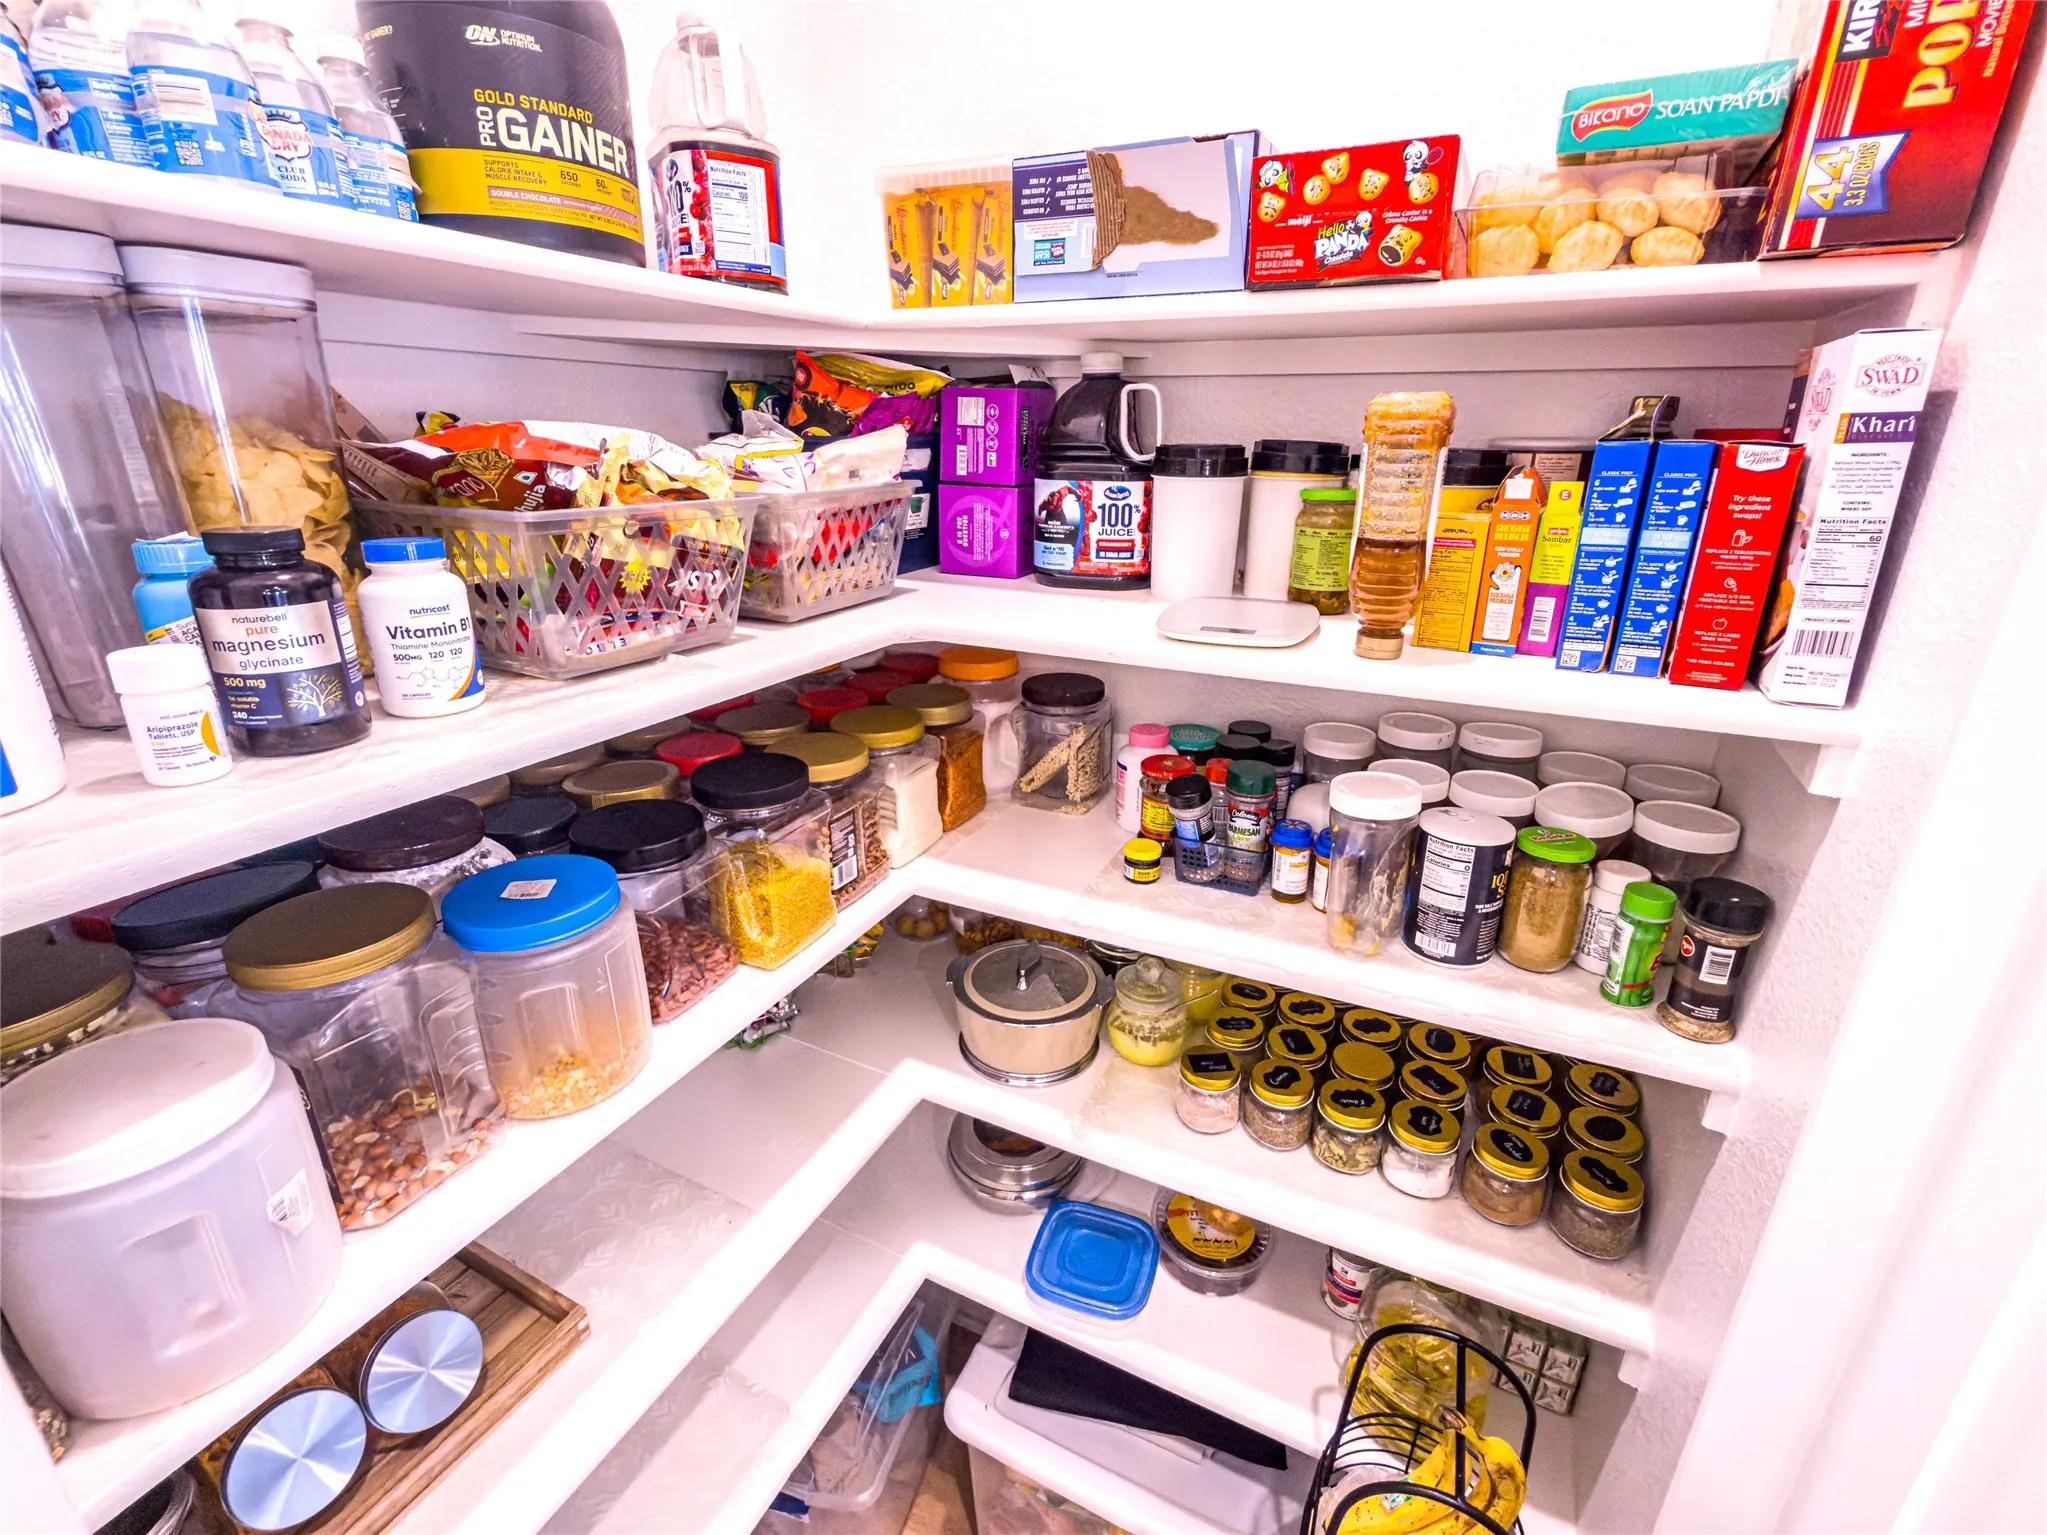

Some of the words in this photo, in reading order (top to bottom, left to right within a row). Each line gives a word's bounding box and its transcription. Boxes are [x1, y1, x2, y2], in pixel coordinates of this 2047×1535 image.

[465, 24, 498, 42] ON
[501, 29, 535, 43] OPTIMUM
[1982, 37, 2003, 78] Natural
[474, 88, 515, 106] GOLD
[519, 95, 593, 125] STANDARD
[1655, 96, 1718, 120] SOAN
[1717, 87, 1784, 113] PAPDI
[476, 106, 497, 147] PRO
[496, 107, 630, 179] GAINER
[1857, 141, 1881, 172] BAGS
[277, 165, 306, 175] CLUB
[483, 159, 520, 169] SUPPORTS
[280, 173, 307, 183] SODA
[484, 166, 512, 175] CALORIE
[513, 169, 537, 178] INTAKE
[560, 170, 579, 183] 650
[710, 166, 733, 175] Nutrition
[733, 168, 747, 177] Facts
[485, 173, 512, 181] MUSCLE
[513, 175, 547, 187] RECOVERY
[1806, 146, 1855, 211] 44
[1850, 170, 1872, 189] OZ
[490, 189, 520, 200] DOUBLE
[520, 192, 562, 205] CHOCOLATE
[712, 190, 731, 198] Calories
[738, 191, 749, 200] 100
[1844, 188, 1867, 207] 3.3
[1385, 216, 1408, 225] Crunchy
[1409, 214, 1428, 222] Cookie
[1402, 209, 1421, 217] Center
[1287, 214, 1314, 227] meiji
[1318, 221, 1346, 239] Hello
[1314, 231, 1370, 258] PANDA
[1324, 250, 1354, 265] Chocolate
[1876, 354, 1893, 366] BEST
[1861, 366, 1920, 386] SWAD
[1881, 387, 1902, 396] TOWN
[1838, 416, 1849, 440] PLAIN
[1851, 415, 1916, 433] Khari
[1742, 448, 1785, 460] Duncan
[1745, 456, 1782, 467] Hines
[1594, 479, 1601, 487] 6
[1655, 481, 1663, 489] 6
[513, 484, 547, 513] hujia
[1561, 491, 1569, 500] E
[1732, 494, 1746, 503] Try
[1747, 494, 1772, 503] these
[1727, 503, 1772, 512] ingredient
[1097, 503, 1142, 528] 100%
[1500, 511, 1531, 520] MDH
[1732, 512, 1763, 520] swaps!
[1819, 518, 1862, 526] Nutrition
[1861, 518, 1887, 526] Facts
[1097, 528, 1134, 537] JUICE
[1495, 523, 1532, 533] DEGGI
[1494, 532, 1530, 541] MIRCH
[1541, 535, 1573, 544] Sambar
[1698, 597, 1728, 605] VEGETABLE
[408, 603, 451, 616] nutricost
[231, 612, 288, 624] naturebell
[245, 625, 279, 637] pure
[385, 620, 458, 640] Vitamin
[459, 616, 471, 632] B1
[211, 632, 326, 656] magnesium
[390, 643, 429, 651] Thiamine
[430, 635, 471, 648] Mononitrate
[393, 653, 423, 662] 500MG
[428, 650, 445, 660] 120
[449, 647, 463, 656] 120
[239, 656, 304, 670] glycinate
[223, 676, 244, 687] 500
[245, 677, 266, 689] mg
[232, 711, 248, 720] 240
[146, 720, 199, 734] Aripiprazole
[147, 730, 180, 741] Tablets,
[180, 729, 196, 738] USP
[1228, 824, 1261, 837] PARMESAN
[1428, 837, 1454, 849] Nutrition
[1455, 845, 1474, 853] Facts
[1426, 855, 1451, 868] Calories
